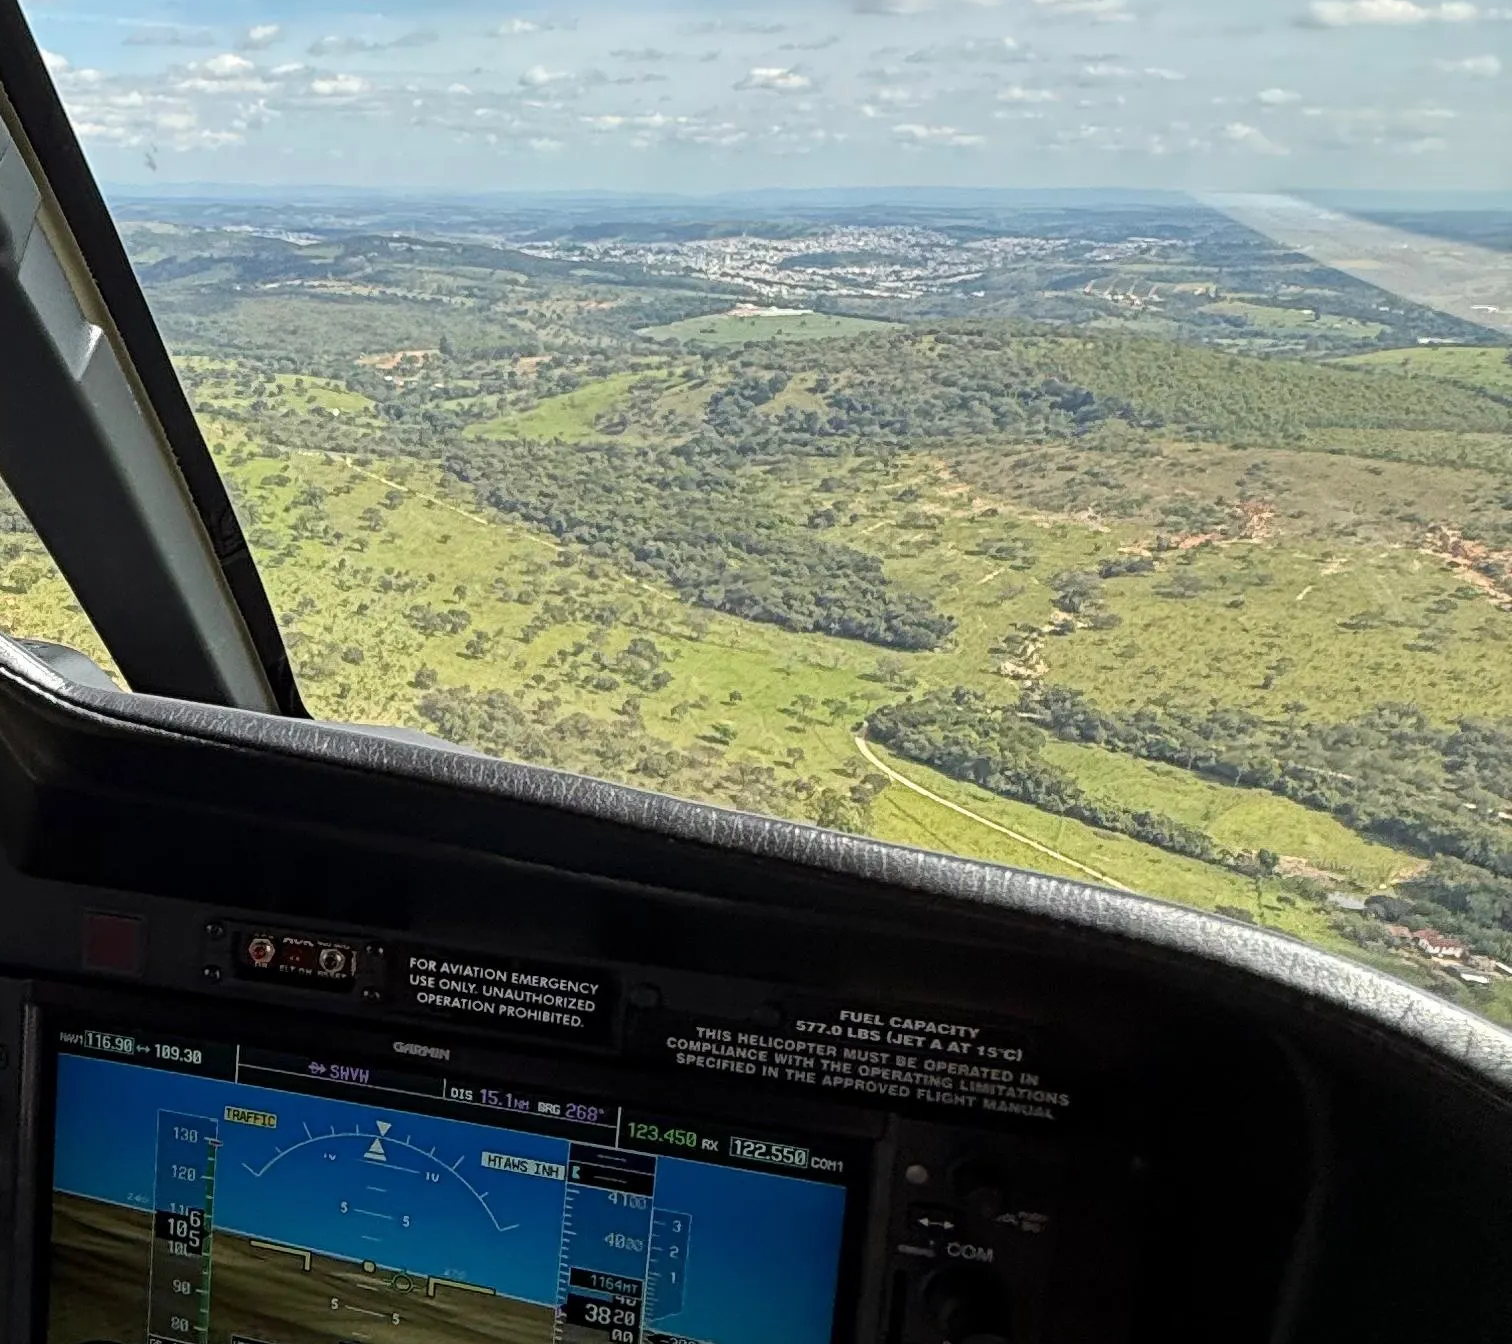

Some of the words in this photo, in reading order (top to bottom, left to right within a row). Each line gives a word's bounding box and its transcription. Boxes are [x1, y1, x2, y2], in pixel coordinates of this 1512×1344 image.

[409, 957, 437, 973] FOR
[440, 962, 507, 983] AVIATION
[510, 971, 599, 996] EMERGENCY
[409, 974, 435, 989] USE
[439, 978, 479, 995] ONLY.
[482, 985, 596, 1012] UNAUTHORIZED
[416, 992, 496, 1015] OPERATION
[498, 1004, 585, 1028] PROHIBITED.
[839, 1009, 885, 1027] FUEL
[889, 1016, 980, 1040] CAPACITY
[87, 1033, 134, 1054] 116.90
[392, 1041, 450, 1061] GARMIN
[795, 1019, 842, 1037] 577.0
[846, 1026, 881, 1042] LBS
[886, 1030, 927, 1049] (JET
[929, 1039, 943, 1051] A
[946, 1041, 972, 1055] AT
[154, 1044, 203, 1064] 109.30
[696, 1026, 732, 1042] THIS
[737, 1032, 837, 1058] HELICOPTER
[843, 1047, 890, 1064] MUST
[895, 1055, 918, 1070] BE
[923, 1058, 1014, 1083] OPERATED
[665, 1036, 768, 1063] COMPLIANCE
[774, 1052, 814, 1069] WITH
[819, 1058, 853, 1075] THE
[857, 1064, 953, 1089] OPERATING
[958, 1078, 1071, 1107] LIMITATIONS
[675, 1053, 757, 1075] SPECIFIED
[761, 1065, 779, 1080] IN
[784, 1068, 817, 1084] THE
[821, 1075, 910, 1098] APPROVED
[916, 1087, 978, 1109] FLIGHT
[450, 1087, 473, 1102] DIS
[537, 1101, 561, 1116] BRG
[226, 1107, 276, 1127] TRAFFIC
[172, 1126, 198, 1143] 130
[627, 1121, 697, 1148] 123.450
[701, 1138, 720, 1153] RX
[733, 1138, 808, 1168] 122.550
[810, 1156, 844, 1173] COM1
[171, 1165, 196, 1182] 120
[487, 1155, 531, 1173] HTAWS
[535, 1163, 560, 1178] INH
[172, 1280, 191, 1295] 90
[171, 1317, 188, 1332] 80
